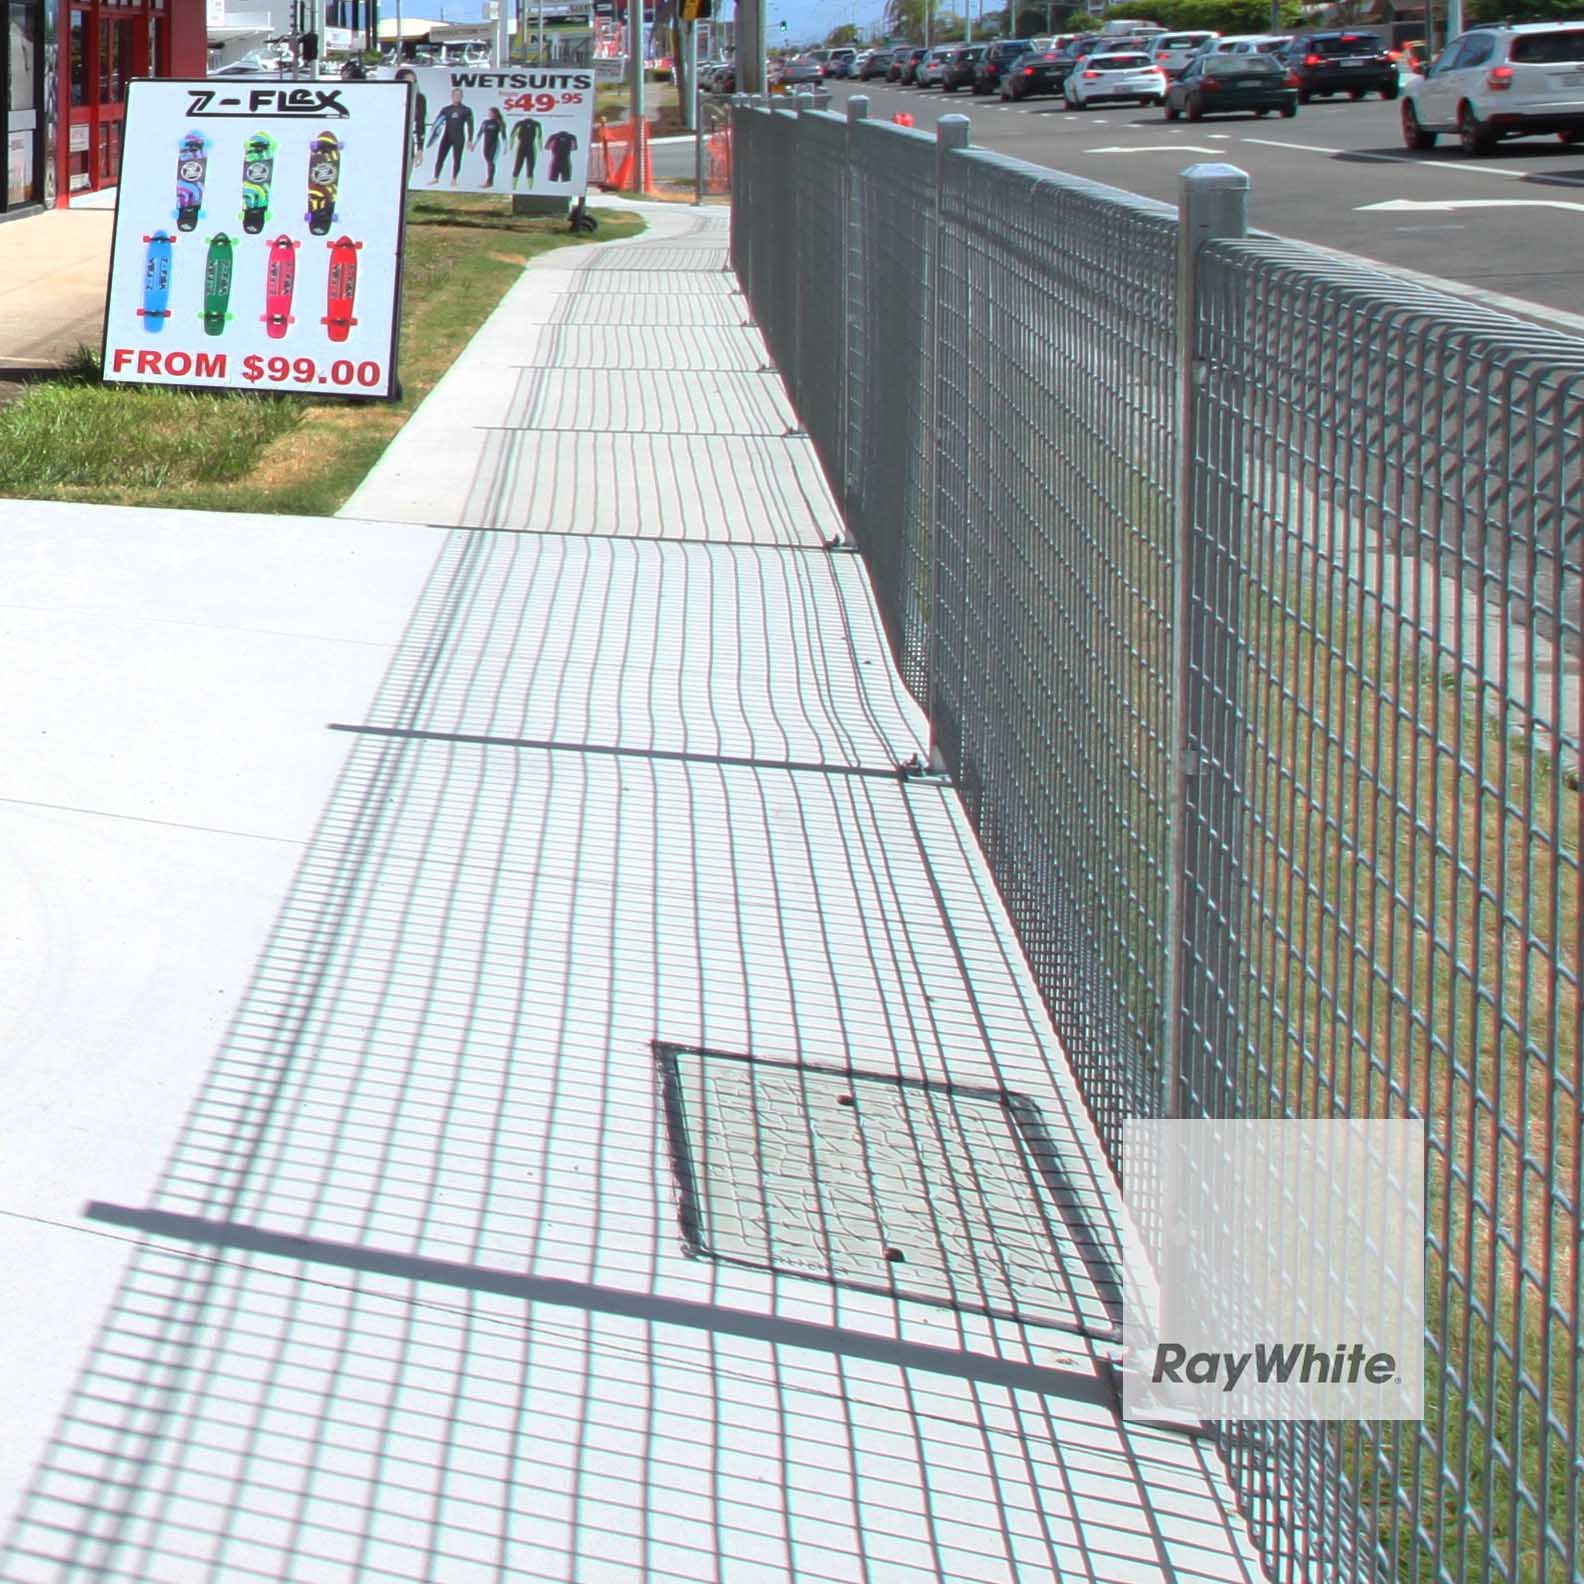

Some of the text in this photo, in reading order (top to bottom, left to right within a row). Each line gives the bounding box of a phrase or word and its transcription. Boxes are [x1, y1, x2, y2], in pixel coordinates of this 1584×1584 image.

[450, 73, 592, 89] WETSUITS
[112, 348, 381, 387] FROM $99.00
